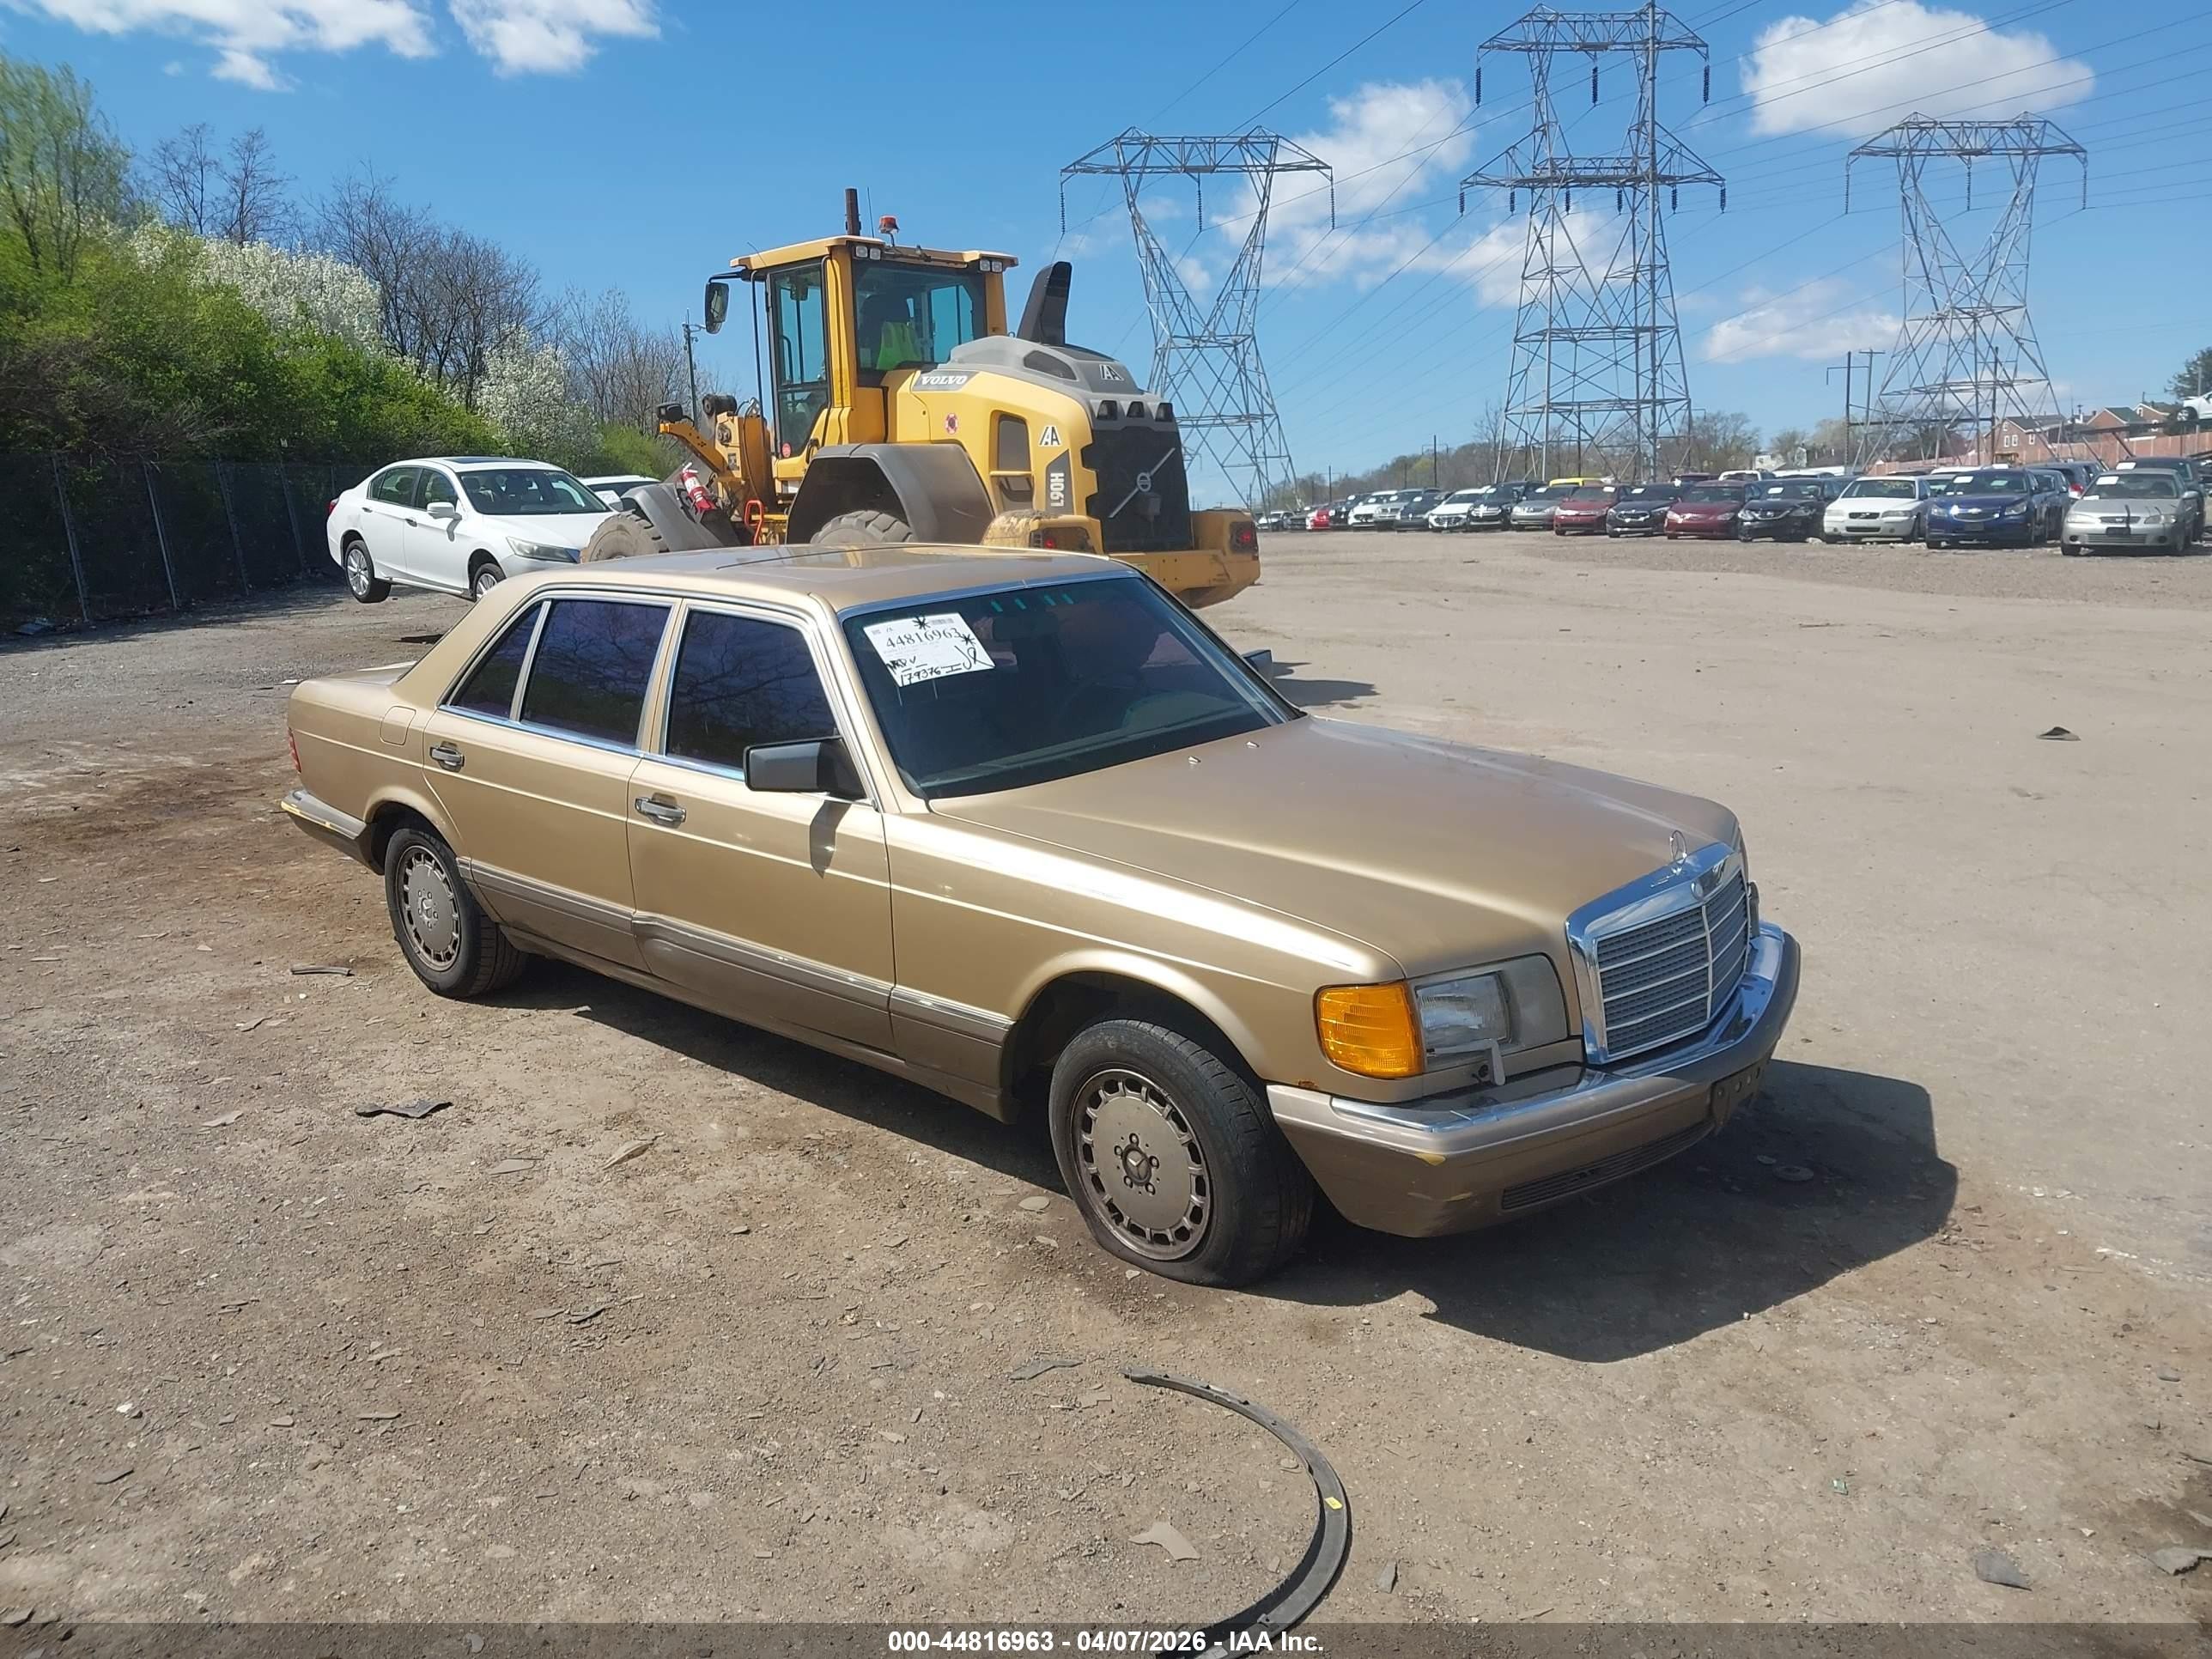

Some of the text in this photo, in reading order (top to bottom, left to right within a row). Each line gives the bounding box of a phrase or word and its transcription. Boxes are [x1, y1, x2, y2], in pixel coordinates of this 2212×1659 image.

[921, 375, 968, 385] VOLVO
[1049, 472, 1065, 507] L90H
[886, 628, 961, 647] 44816963
